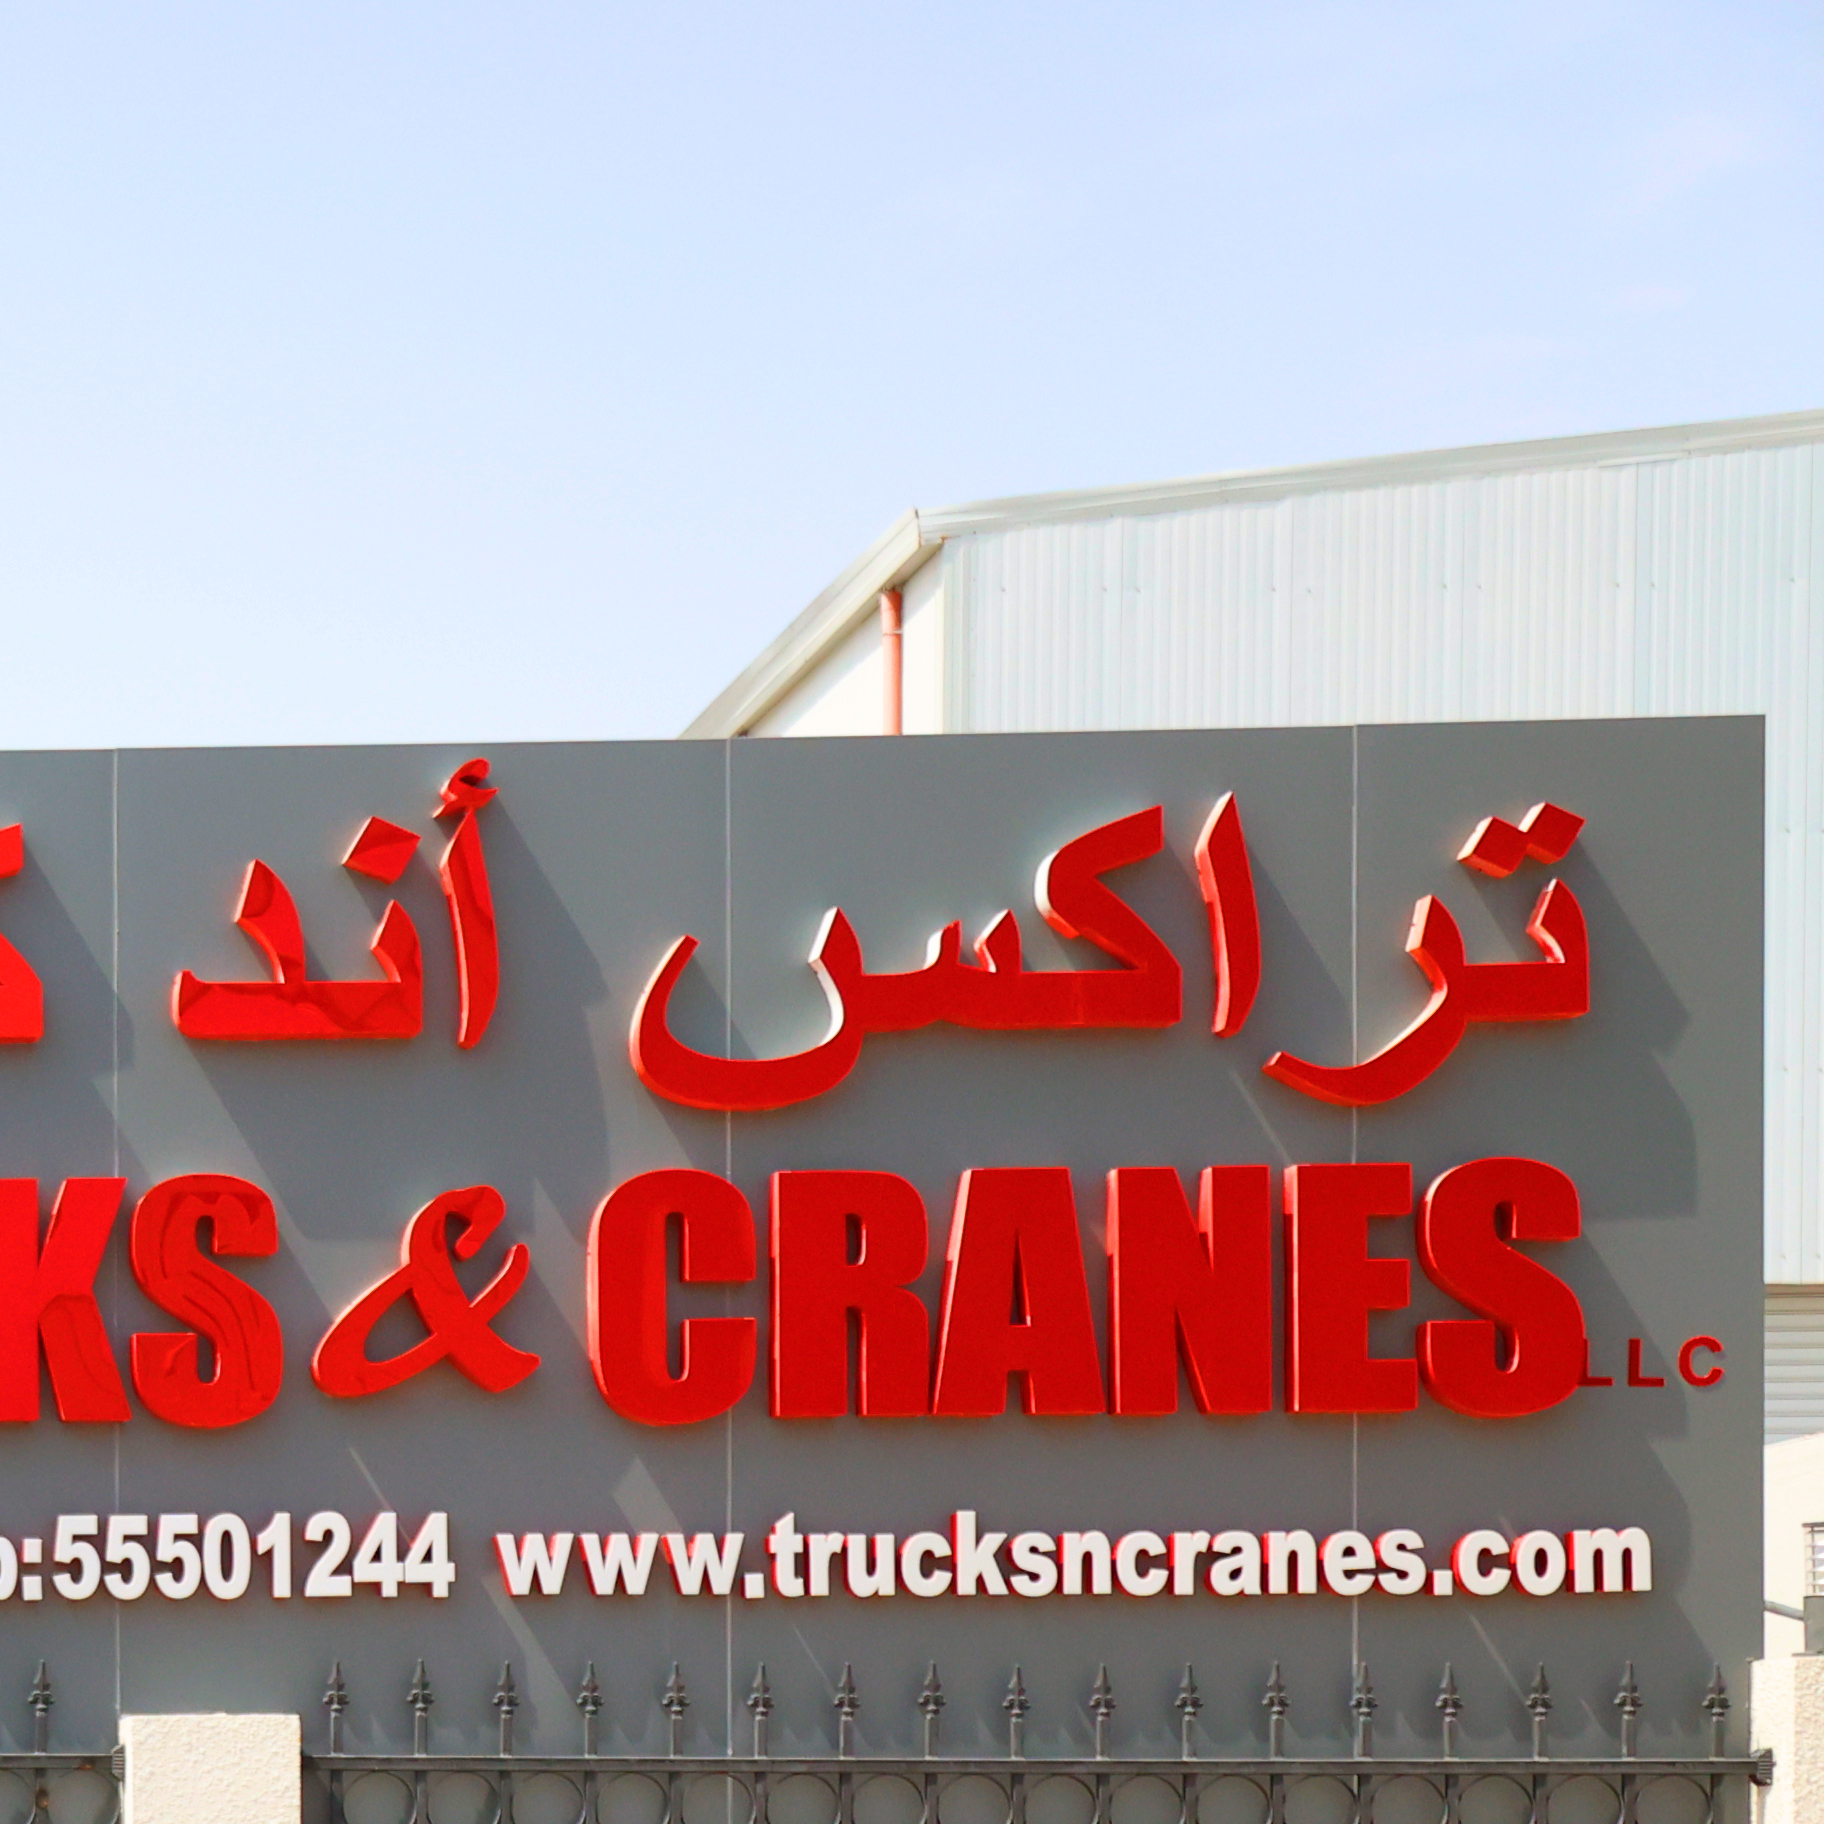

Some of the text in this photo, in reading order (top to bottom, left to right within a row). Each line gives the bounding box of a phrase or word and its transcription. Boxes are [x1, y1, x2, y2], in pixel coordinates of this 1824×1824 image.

[172, 757, 499, 1050] أند
[629, 790, 1589, 1112] تراكس
[311, 1184, 541, 1398] &
[586, 1156, 1587, 1427] CRANES
[1577, 1334, 1725, 1388] LLC
[496, 1510, 1654, 1602] www.trucksncranes.com
